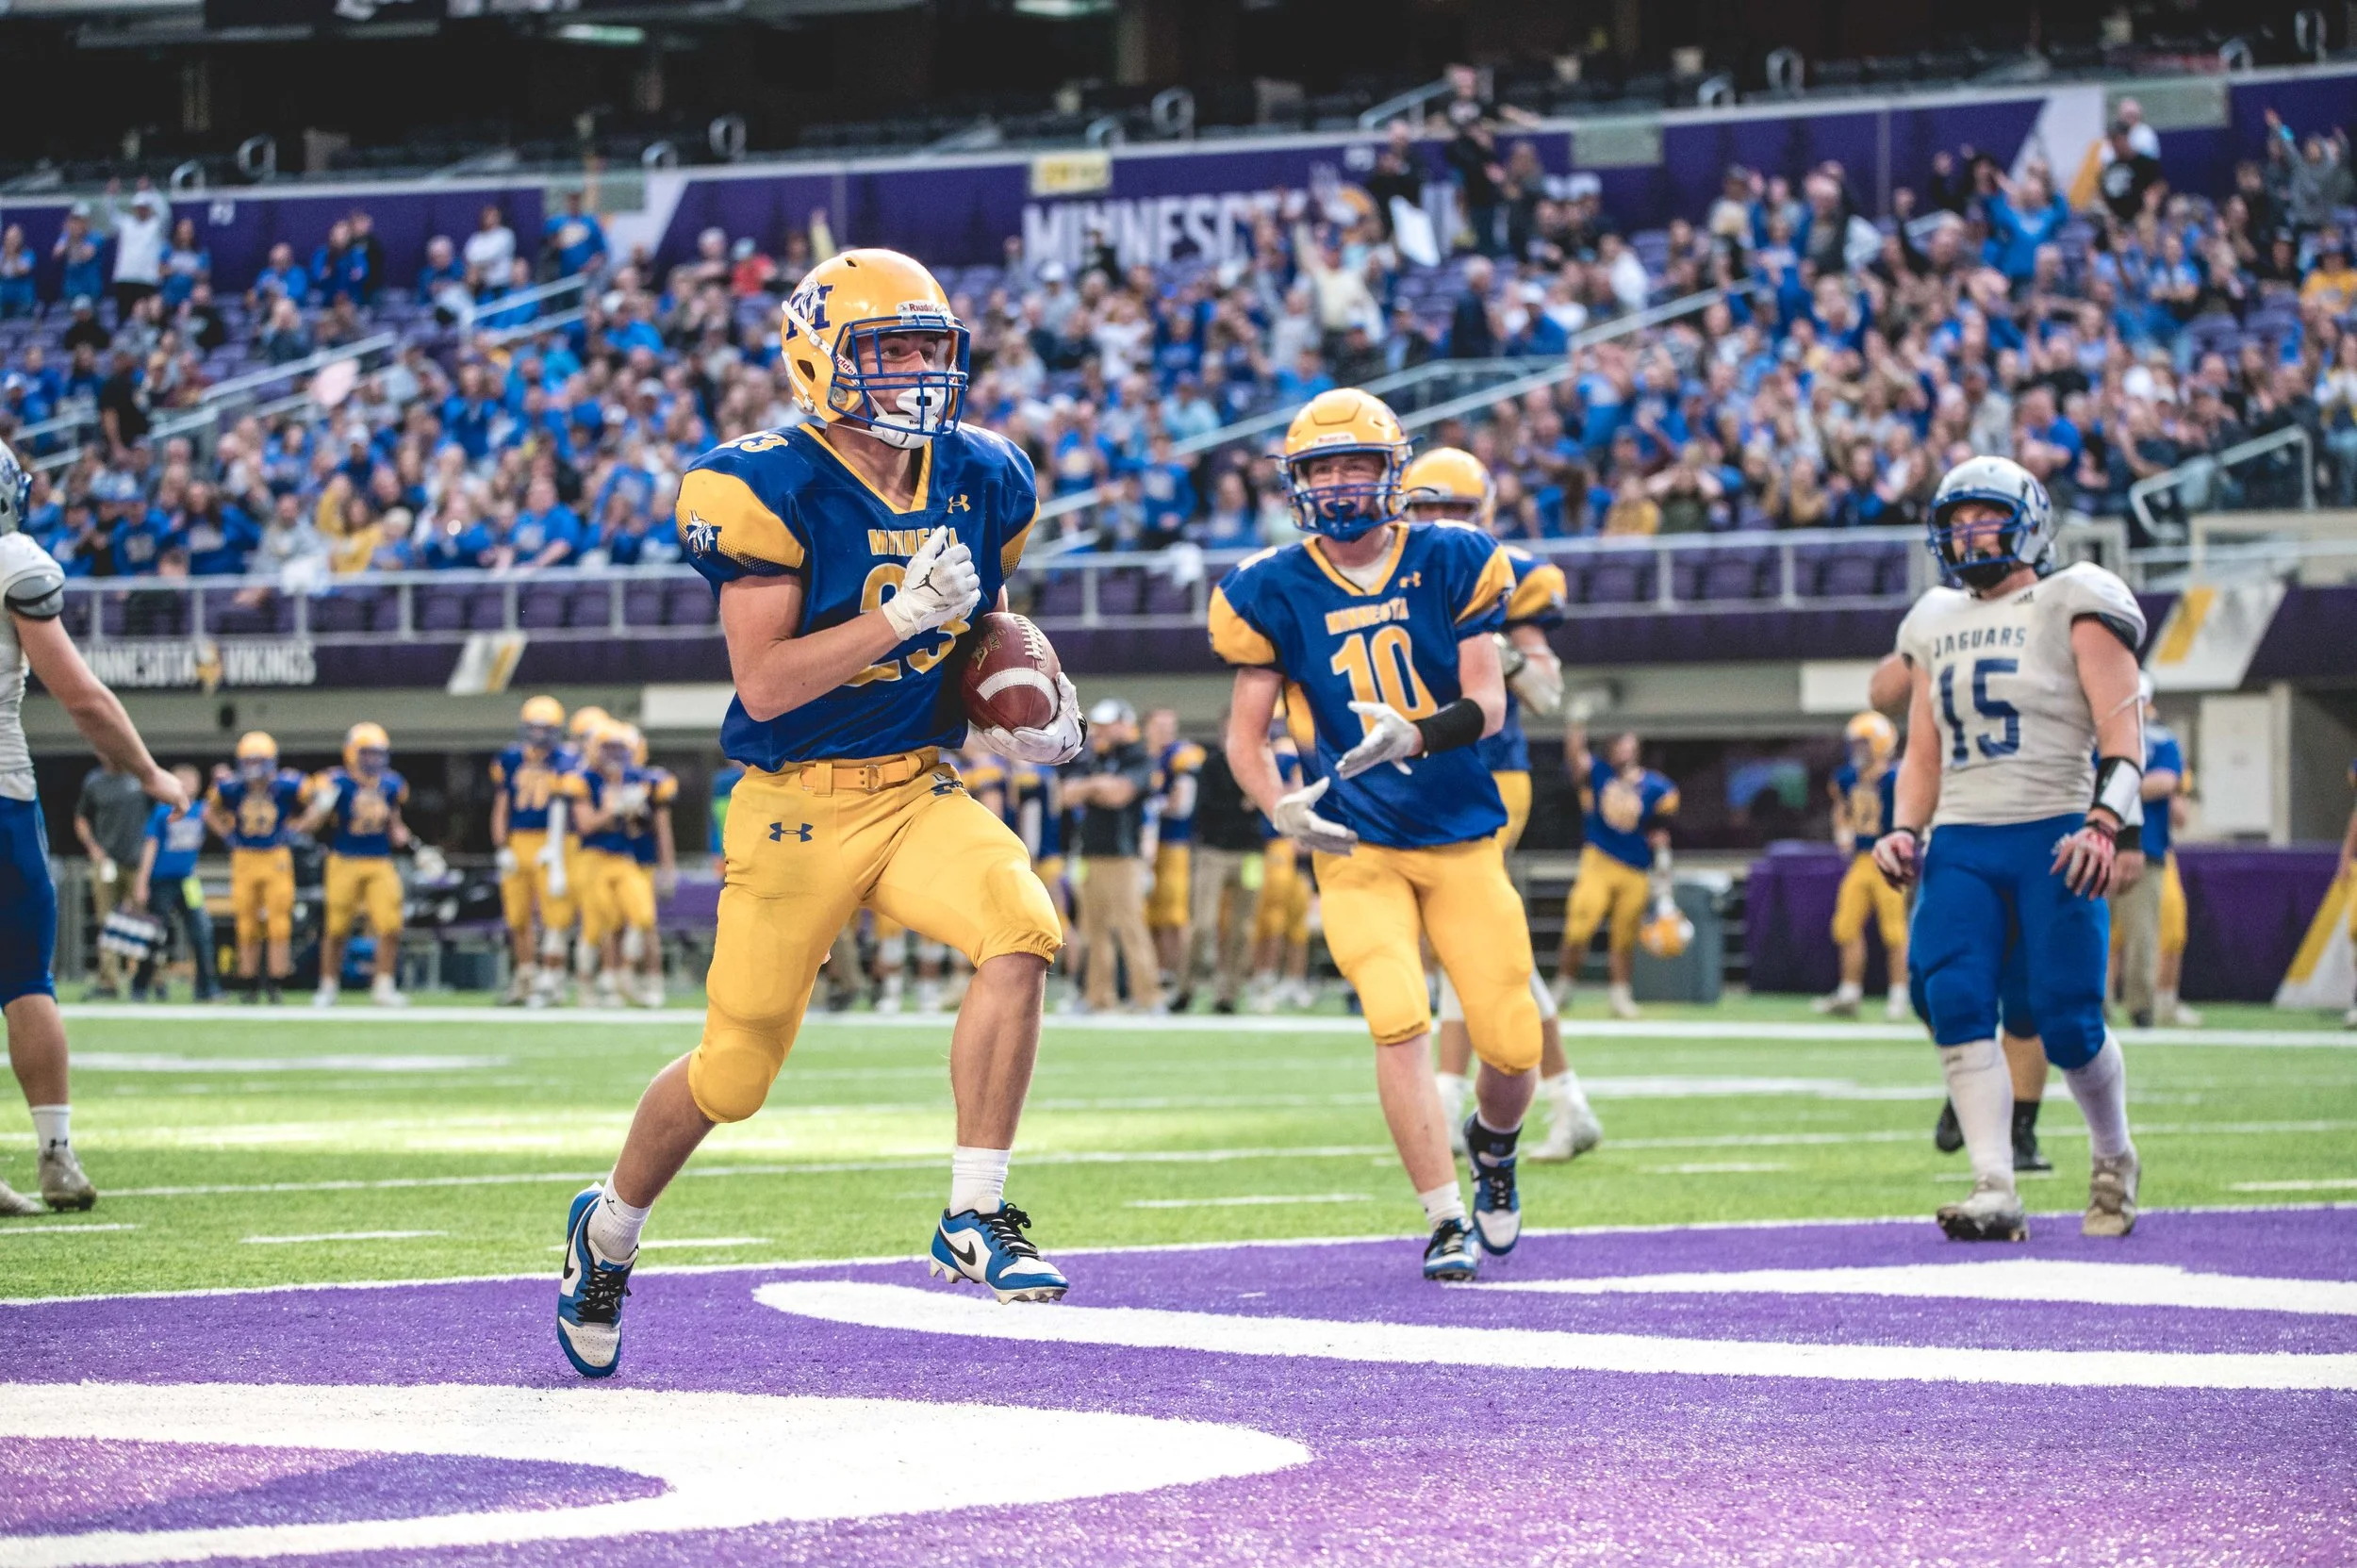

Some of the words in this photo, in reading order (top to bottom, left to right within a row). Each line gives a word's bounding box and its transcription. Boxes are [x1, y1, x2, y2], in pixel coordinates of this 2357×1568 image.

[1330, 625, 1438, 737] 10
[1934, 626, 2026, 659] JAGUARS
[1938, 658, 2020, 768] 15
